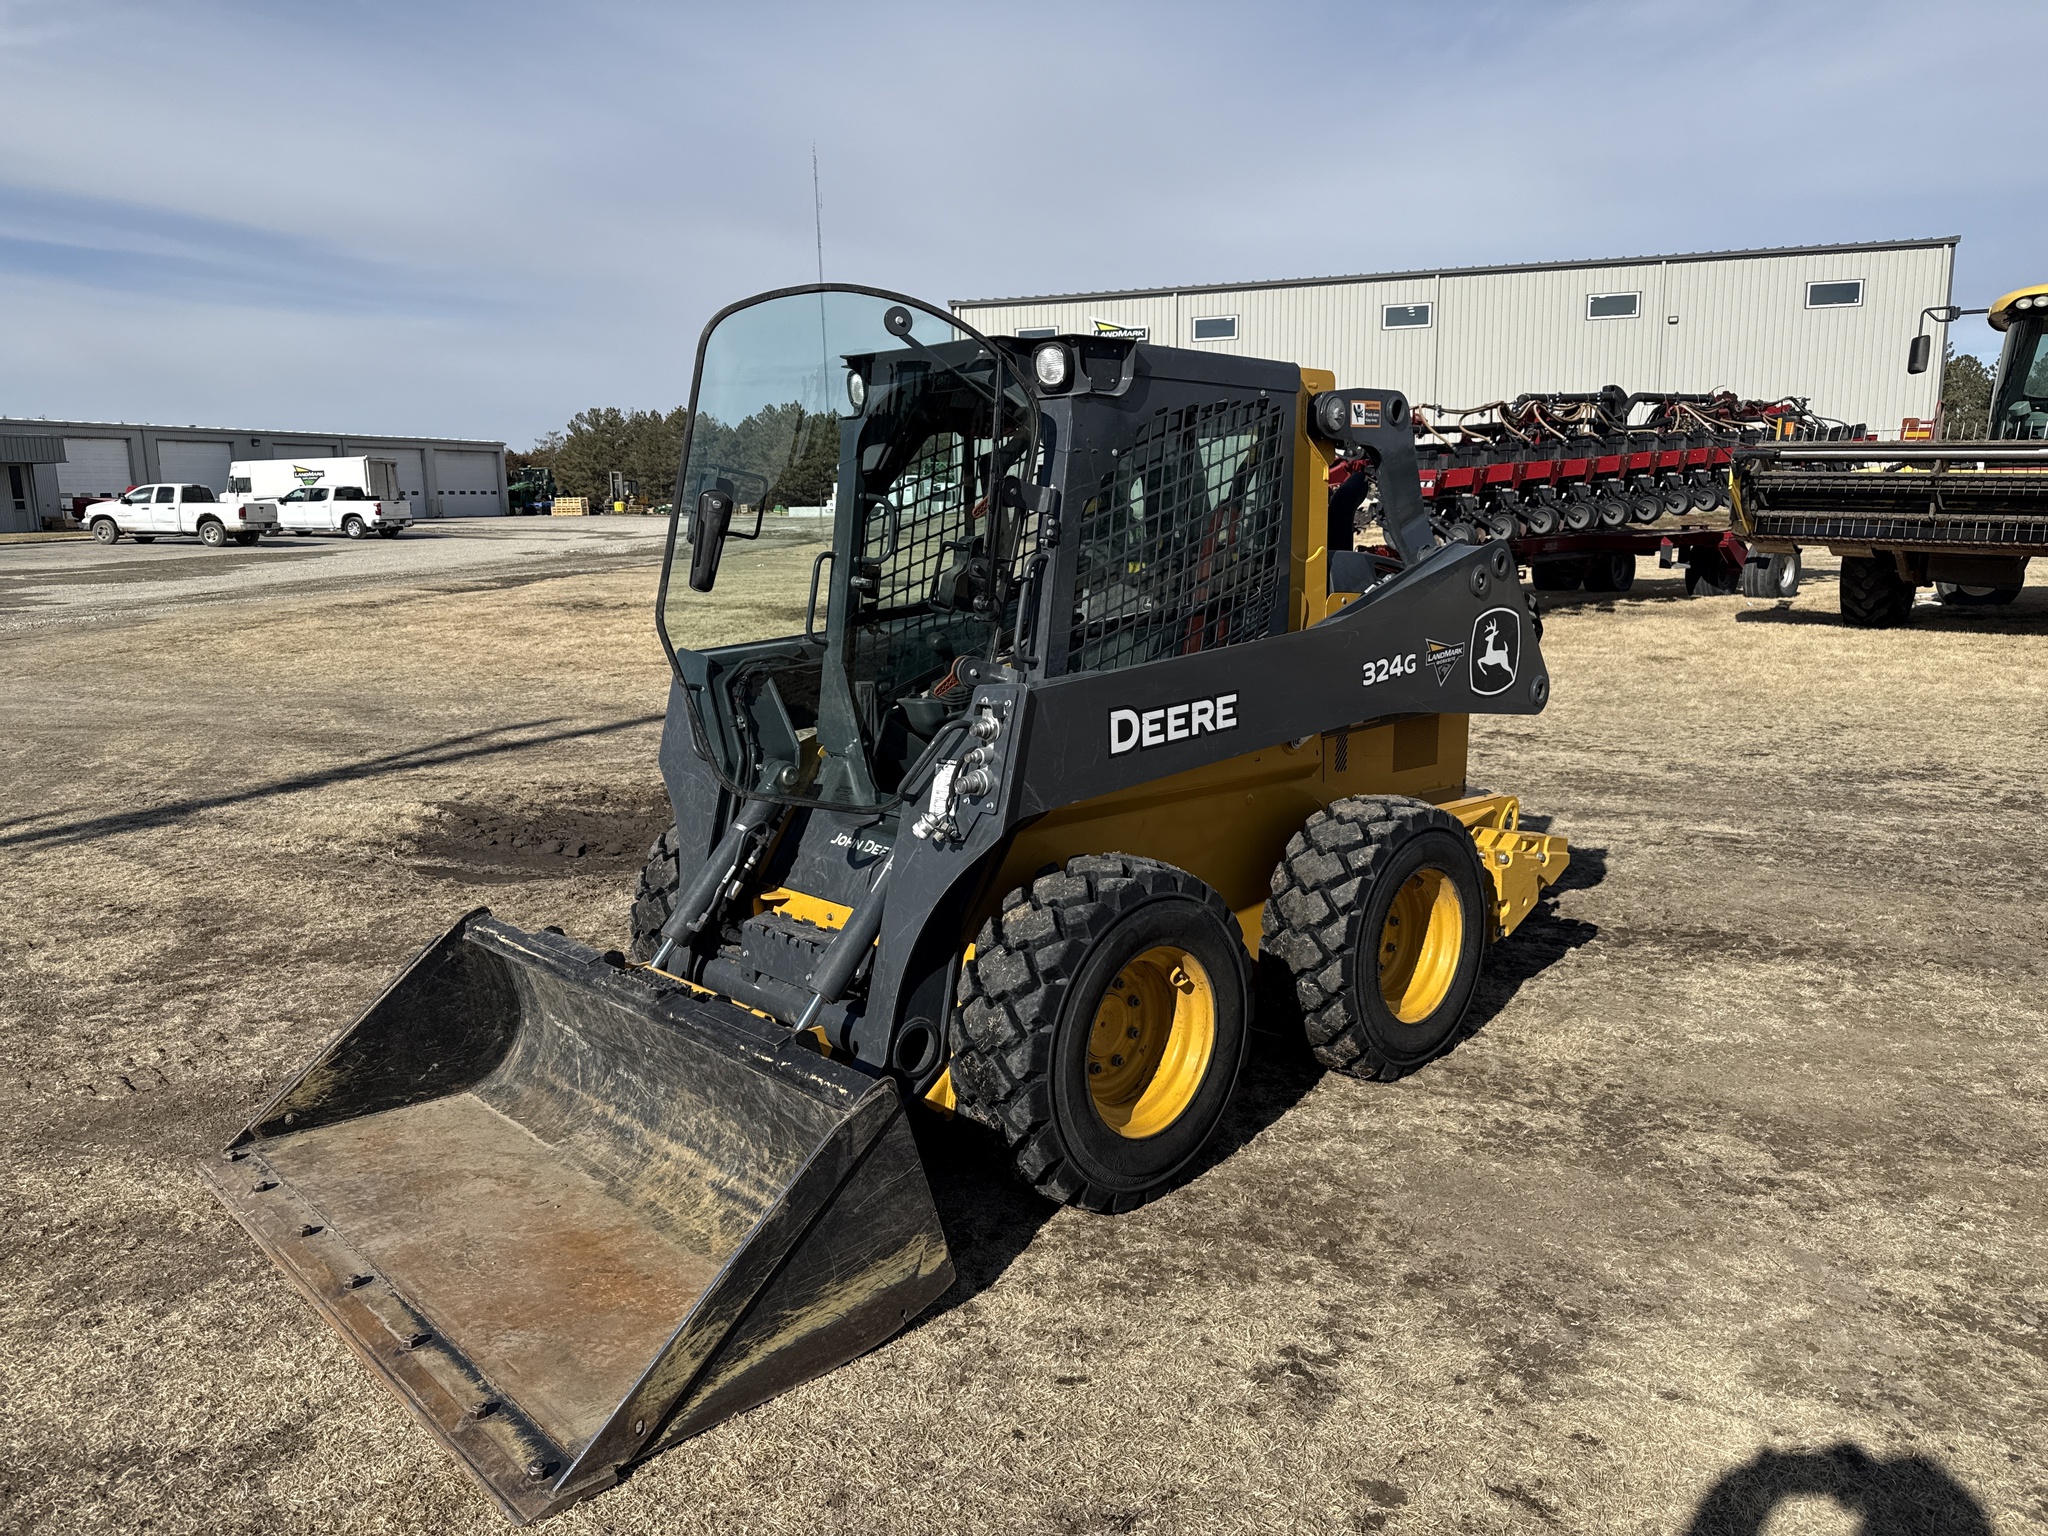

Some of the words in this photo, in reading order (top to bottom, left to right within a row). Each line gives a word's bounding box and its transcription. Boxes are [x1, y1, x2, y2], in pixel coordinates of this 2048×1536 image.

[1363, 653, 1417, 686] 324G
[1110, 693, 1237, 755] DEERE
[830, 832, 864, 850] JOHN
